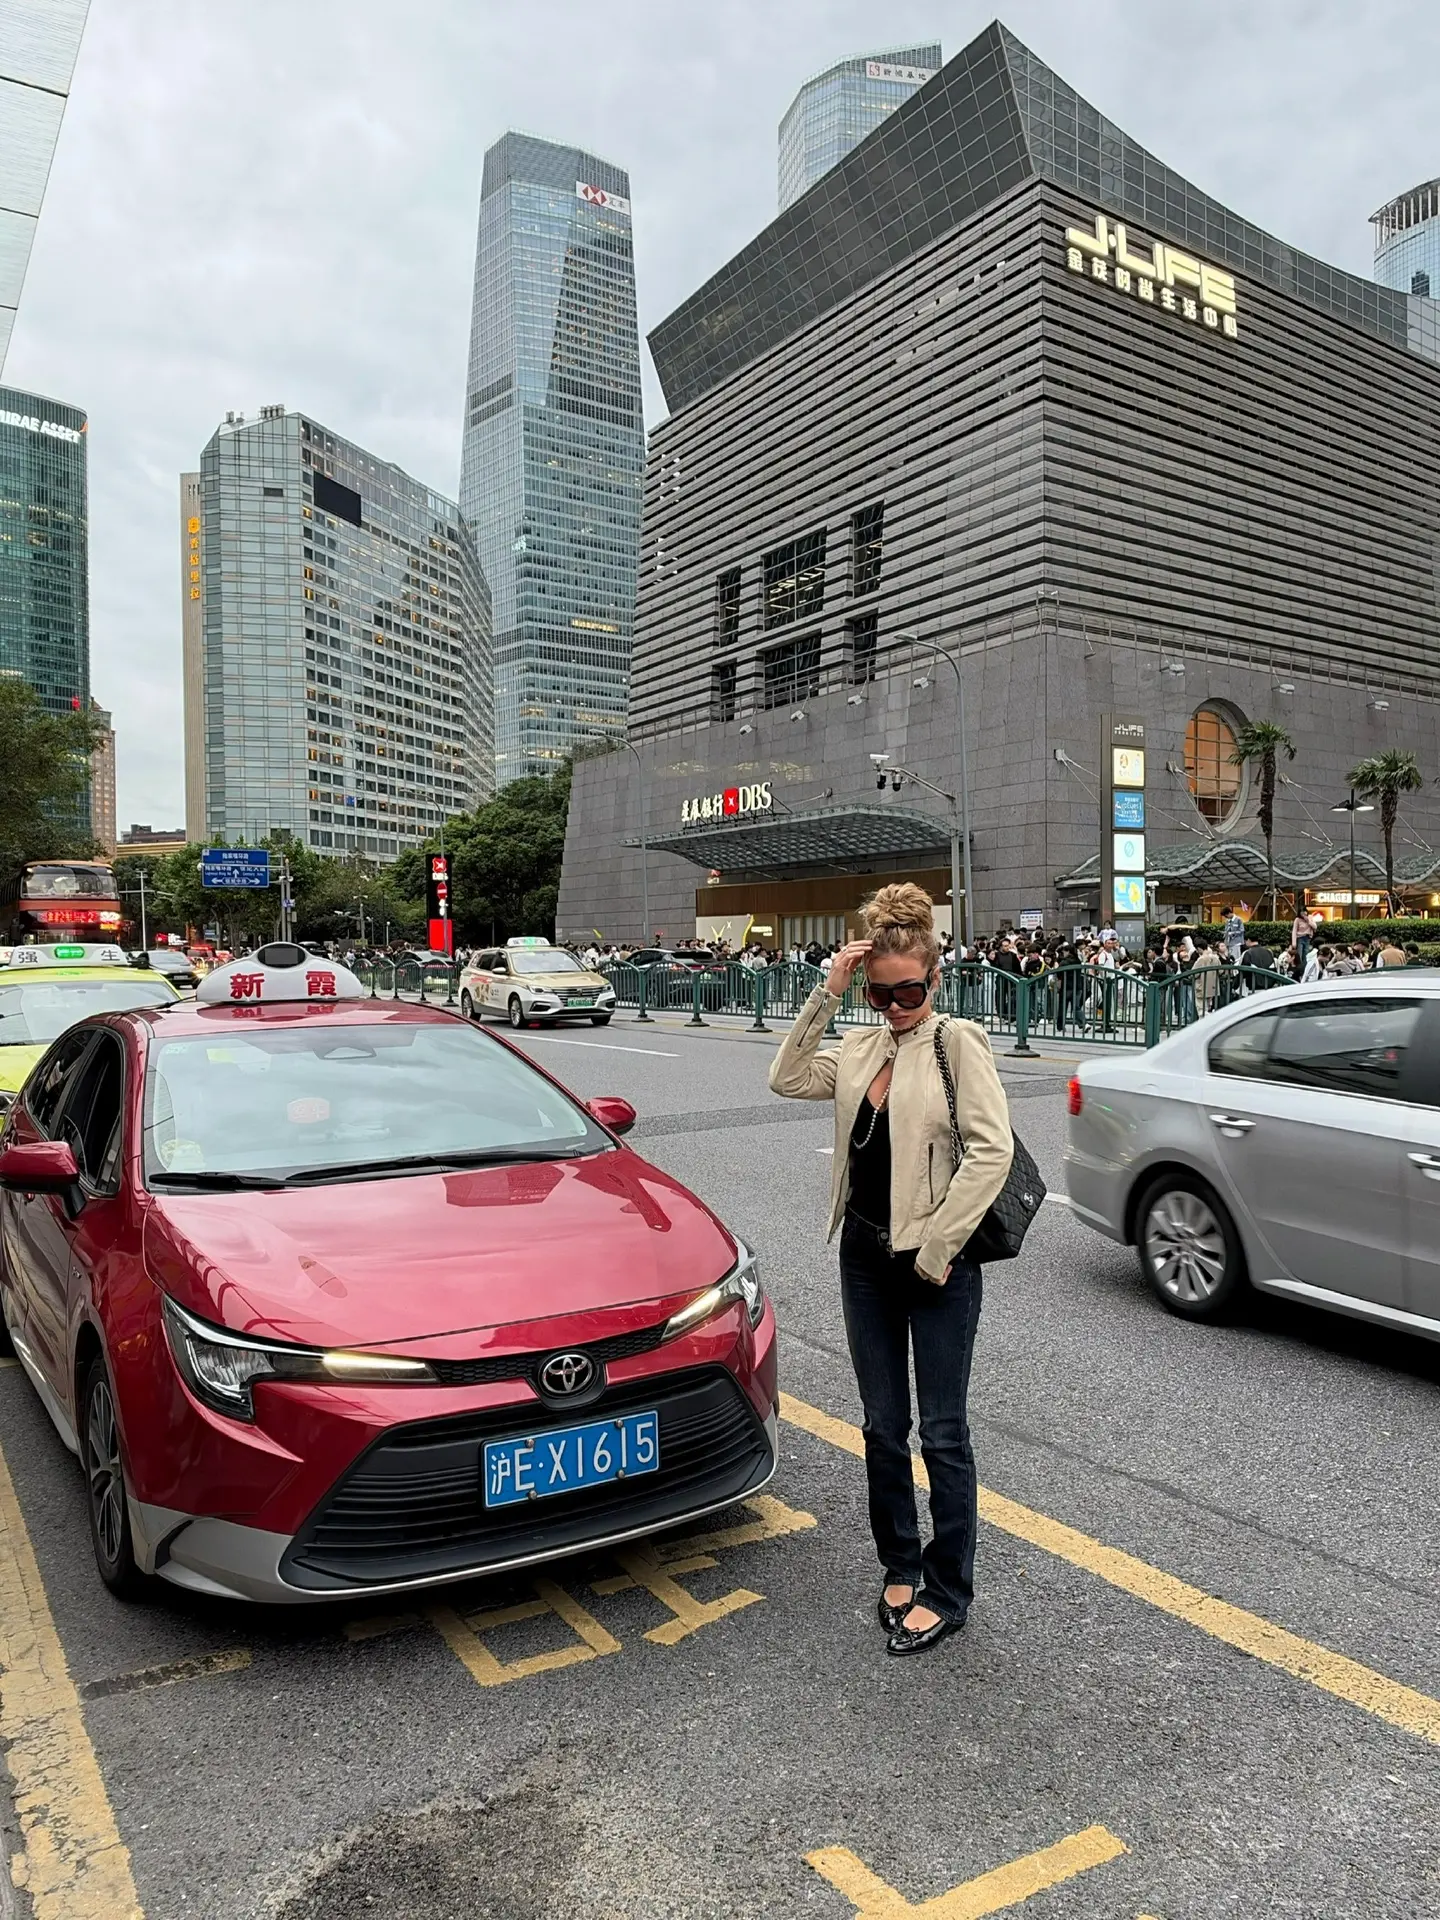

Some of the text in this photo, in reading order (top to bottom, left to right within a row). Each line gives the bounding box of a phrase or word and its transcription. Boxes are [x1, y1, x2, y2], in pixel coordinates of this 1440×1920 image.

[1066, 247, 1237, 338] 金茂时尚生活中心
[40, 421, 80, 443] ASSET
[739, 782, 772, 812] DBS
[230, 971, 337, 999] 新霞
[491, 1422, 654, 1495] 沪E·X1615
